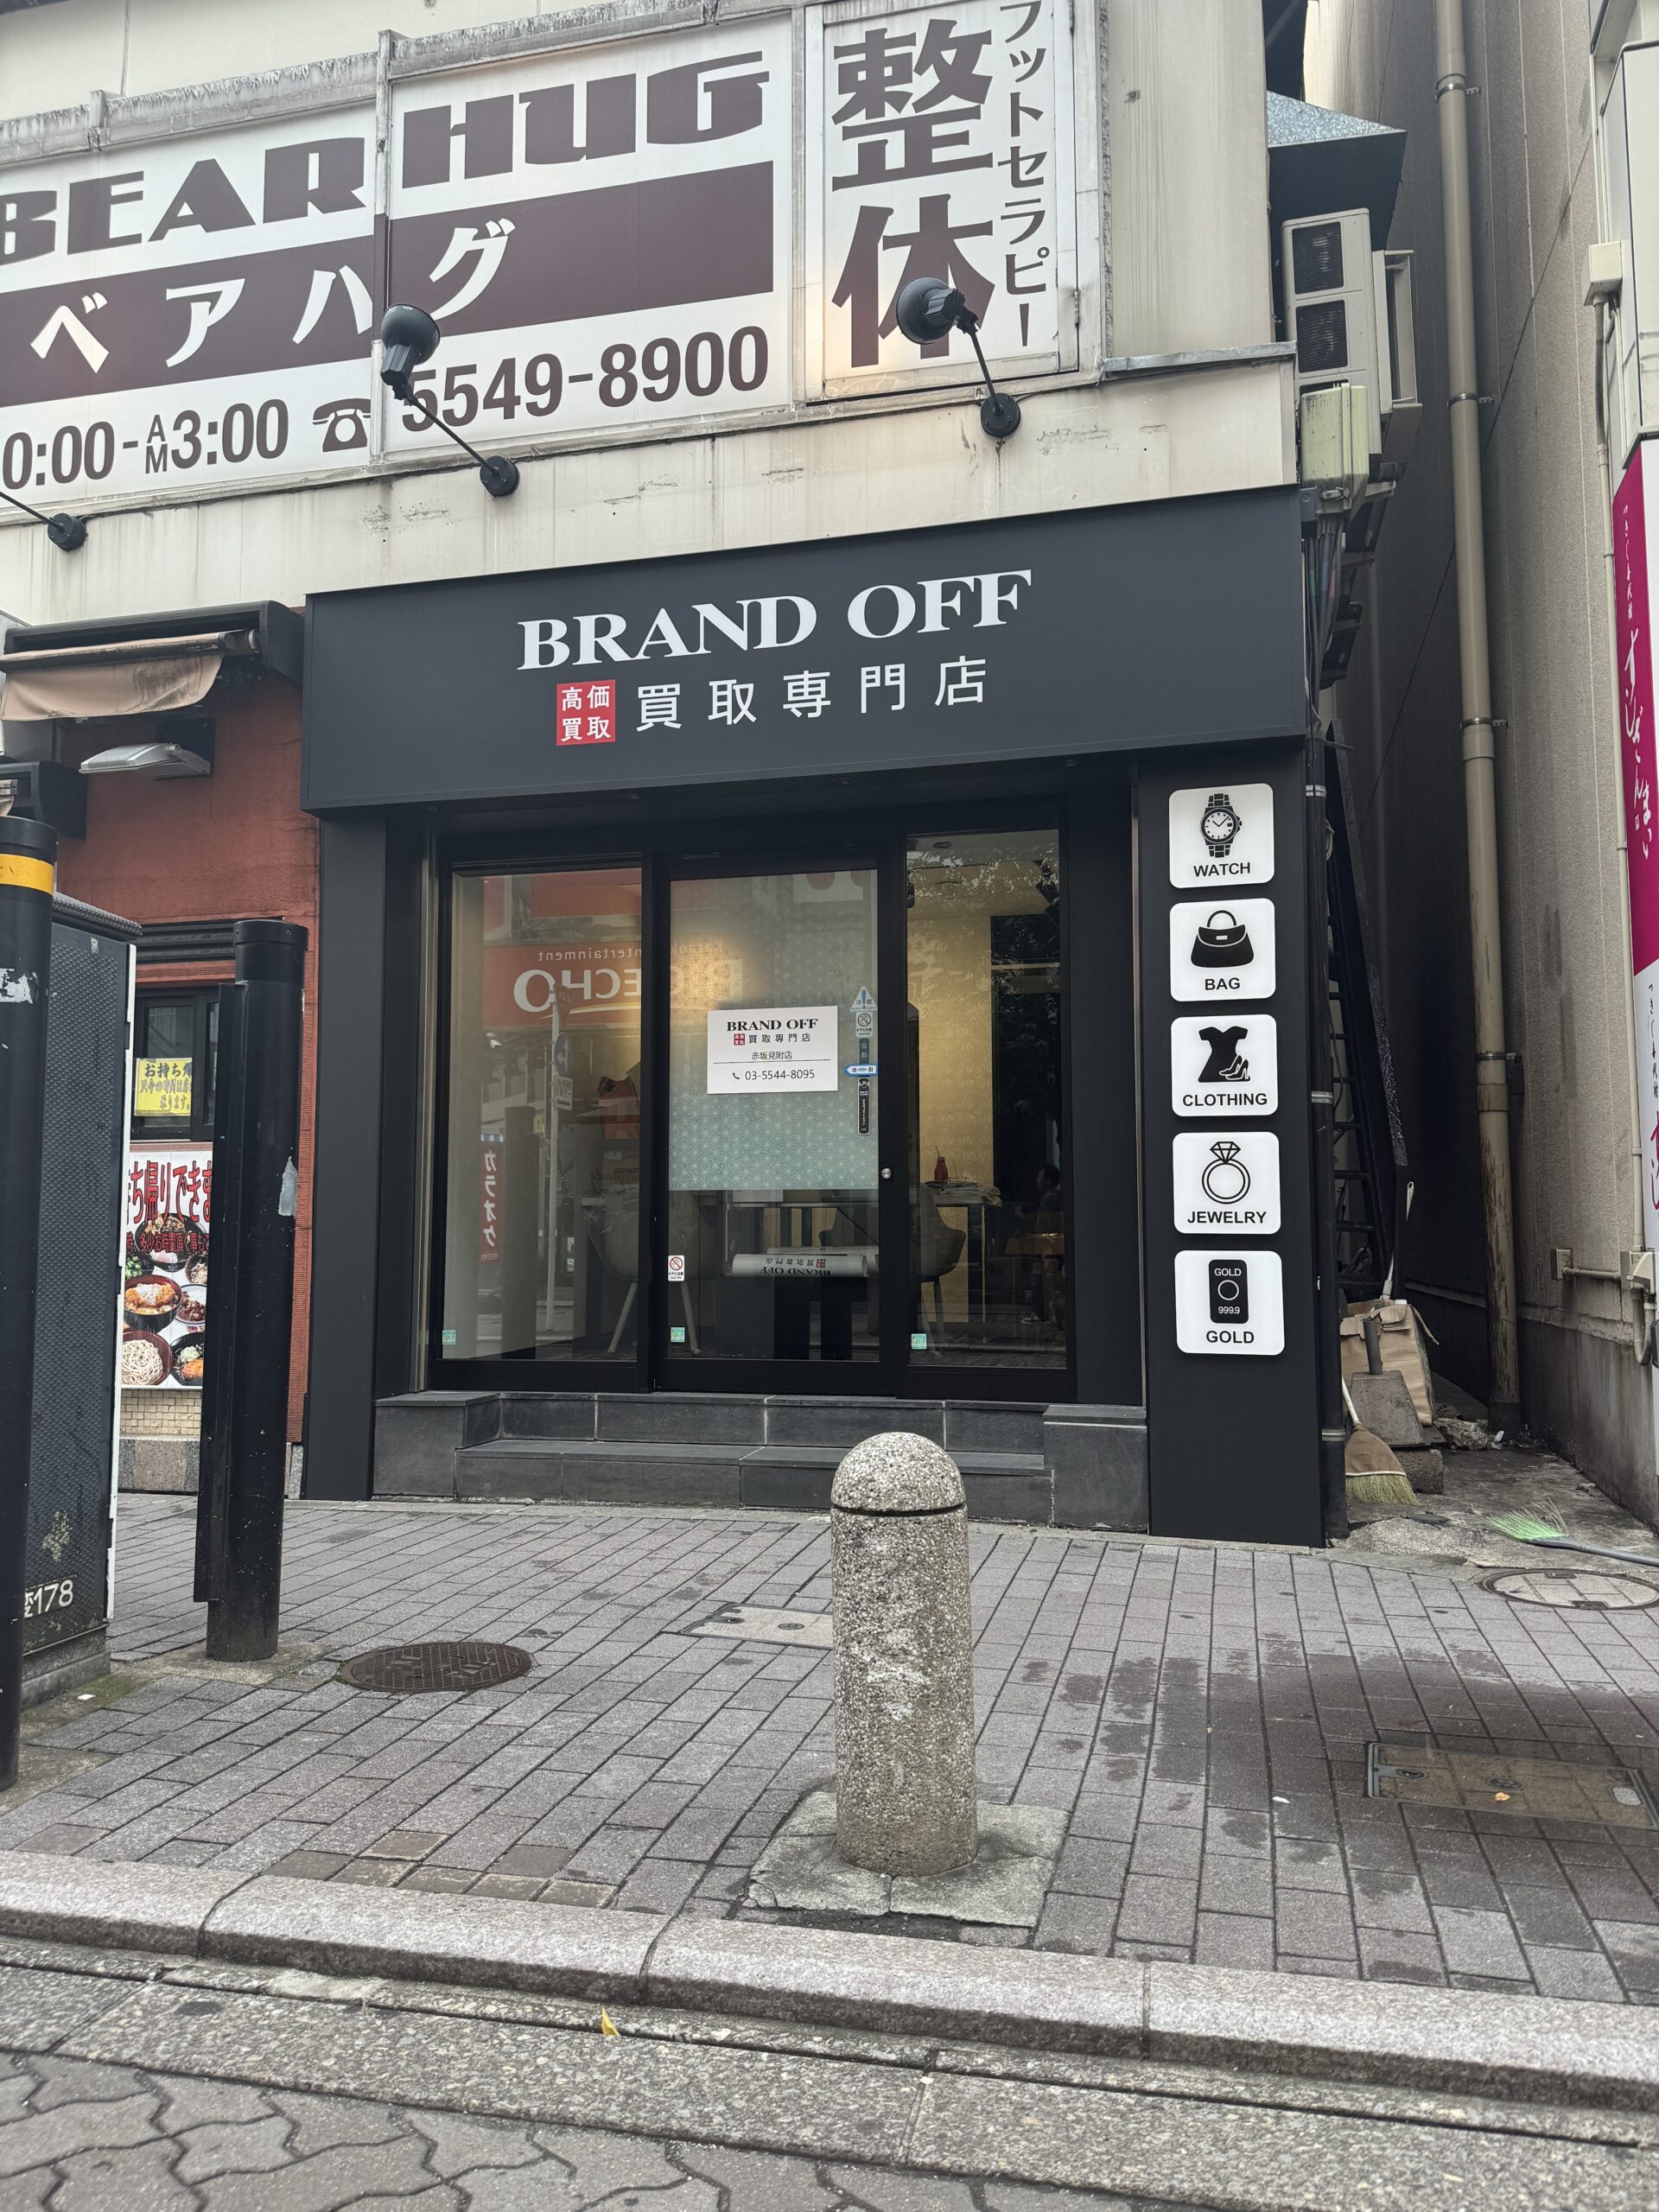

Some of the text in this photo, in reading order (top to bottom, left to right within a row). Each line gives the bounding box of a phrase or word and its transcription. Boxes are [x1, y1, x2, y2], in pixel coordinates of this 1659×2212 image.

[0, 50, 770, 266] BEAR HUG
[998, 1, 1050, 347] フットセラピー
[832, 19, 996, 369] 整体
[31, 218, 516, 373] ベアハグ
[402, 325, 768, 432] 5549-8900
[517, 569, 1032, 671] BRAND OFF
[562, 684, 610, 711] 高価
[636, 655, 987, 732] 買取専門店
[561, 715, 610, 742] 買取
[1192, 861, 1252, 878] WATCH
[1204, 977, 1241, 991] BAG
[726, 1018, 818, 1032] BRAND OFF
[748, 1033, 811, 1044] 買取専門店
[751, 1051, 792, 1061] 赤坂見附店
[745, 1069, 815, 1080] 03-5544-8095
[1181, 1092, 1268, 1108] CLOTHING
[127, 1160, 212, 1224] ち帰りできま
[1187, 1210, 1268, 1226] JEWELRY
[1214, 1268, 1242, 1276] GOLD
[1217, 1306, 1241, 1314] 999.9
[1205, 1330, 1255, 1344] GOLD
